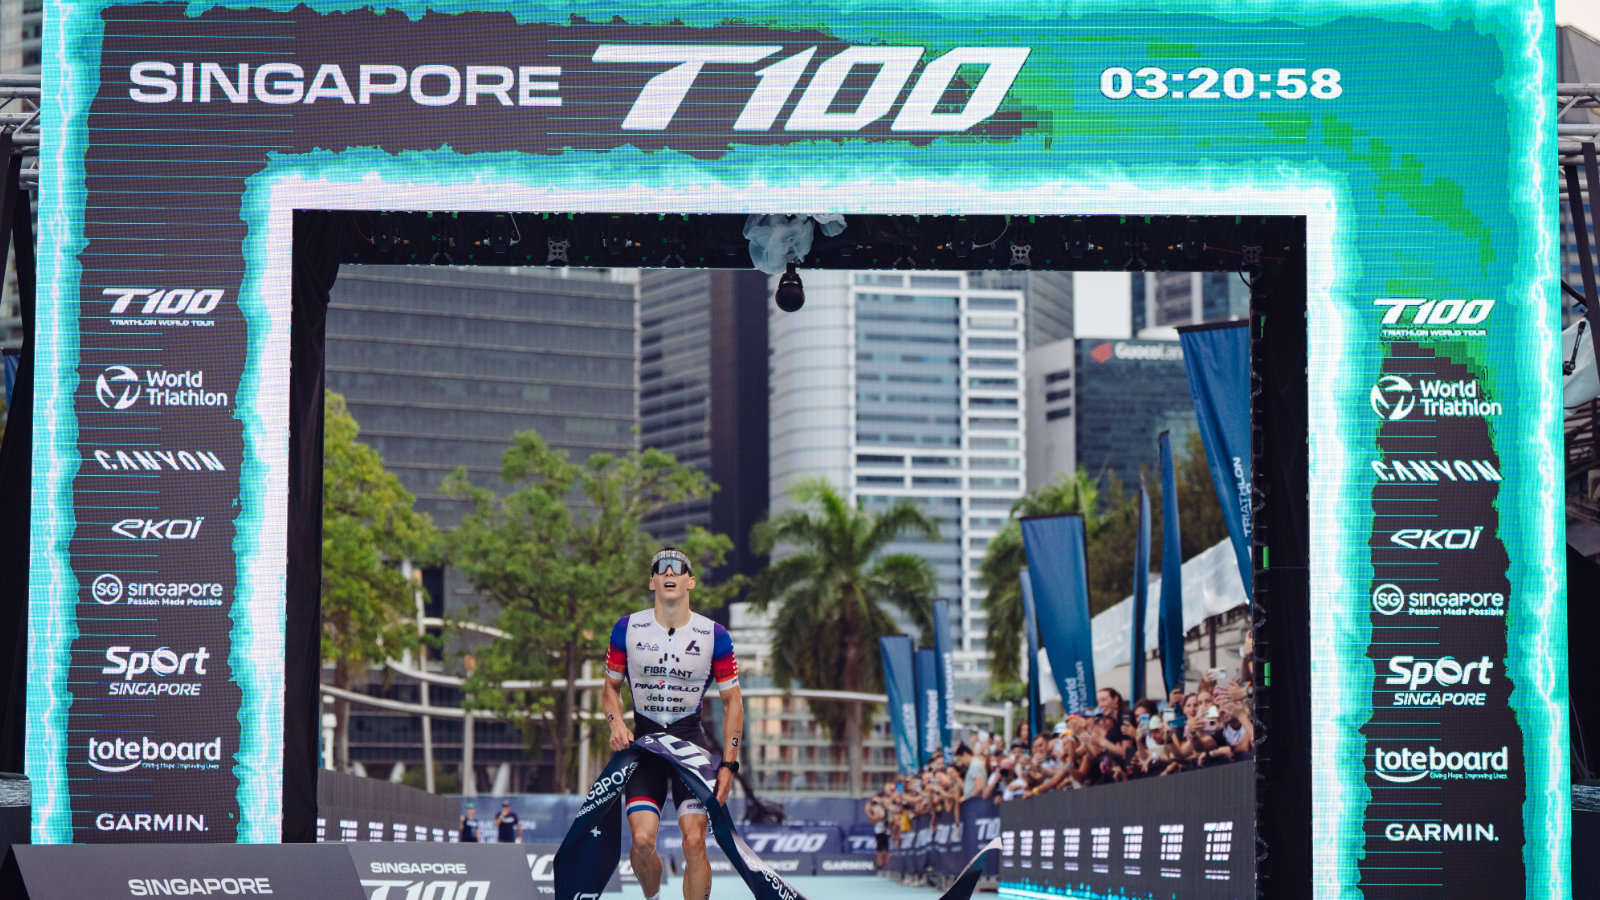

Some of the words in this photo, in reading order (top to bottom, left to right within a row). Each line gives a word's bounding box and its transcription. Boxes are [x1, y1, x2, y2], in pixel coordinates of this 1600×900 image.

[129, 61, 562, 107] SINGAPORE
[592, 45, 1032, 131] T100
[1100, 66, 1343, 99] 03:20:58
[102, 288, 225, 314] T100
[1373, 298, 1496, 324] T100
[146, 370, 203, 387] World
[145, 388, 228, 406] Triathlon
[1419, 380, 1477, 397] World
[1419, 398, 1502, 416] Triathlon
[94, 449, 225, 471] CANYON
[1371, 460, 1504, 481] CANYON
[1233, 456, 1252, 538] TRIATHLON
[186, 598, 223, 606] Possible
[1408, 608, 1442, 616] Passion
[1443, 608, 1467, 616] Made
[1468, 607, 1504, 616] Possible
[102, 646, 210, 680] Sport
[644, 666, 693, 678] FIBRANT
[1386, 656, 1494, 690] Sport
[109, 682, 202, 695] SINGAPORE
[1393, 693, 1487, 706] SINGAPORE
[644, 705, 686, 713] KEULEN
[731, 737, 739, 747] 3
[747, 833, 827, 852] T100
[370, 862, 468, 874] SINGAPORE
[128, 878, 273, 896] SINGAPORE
